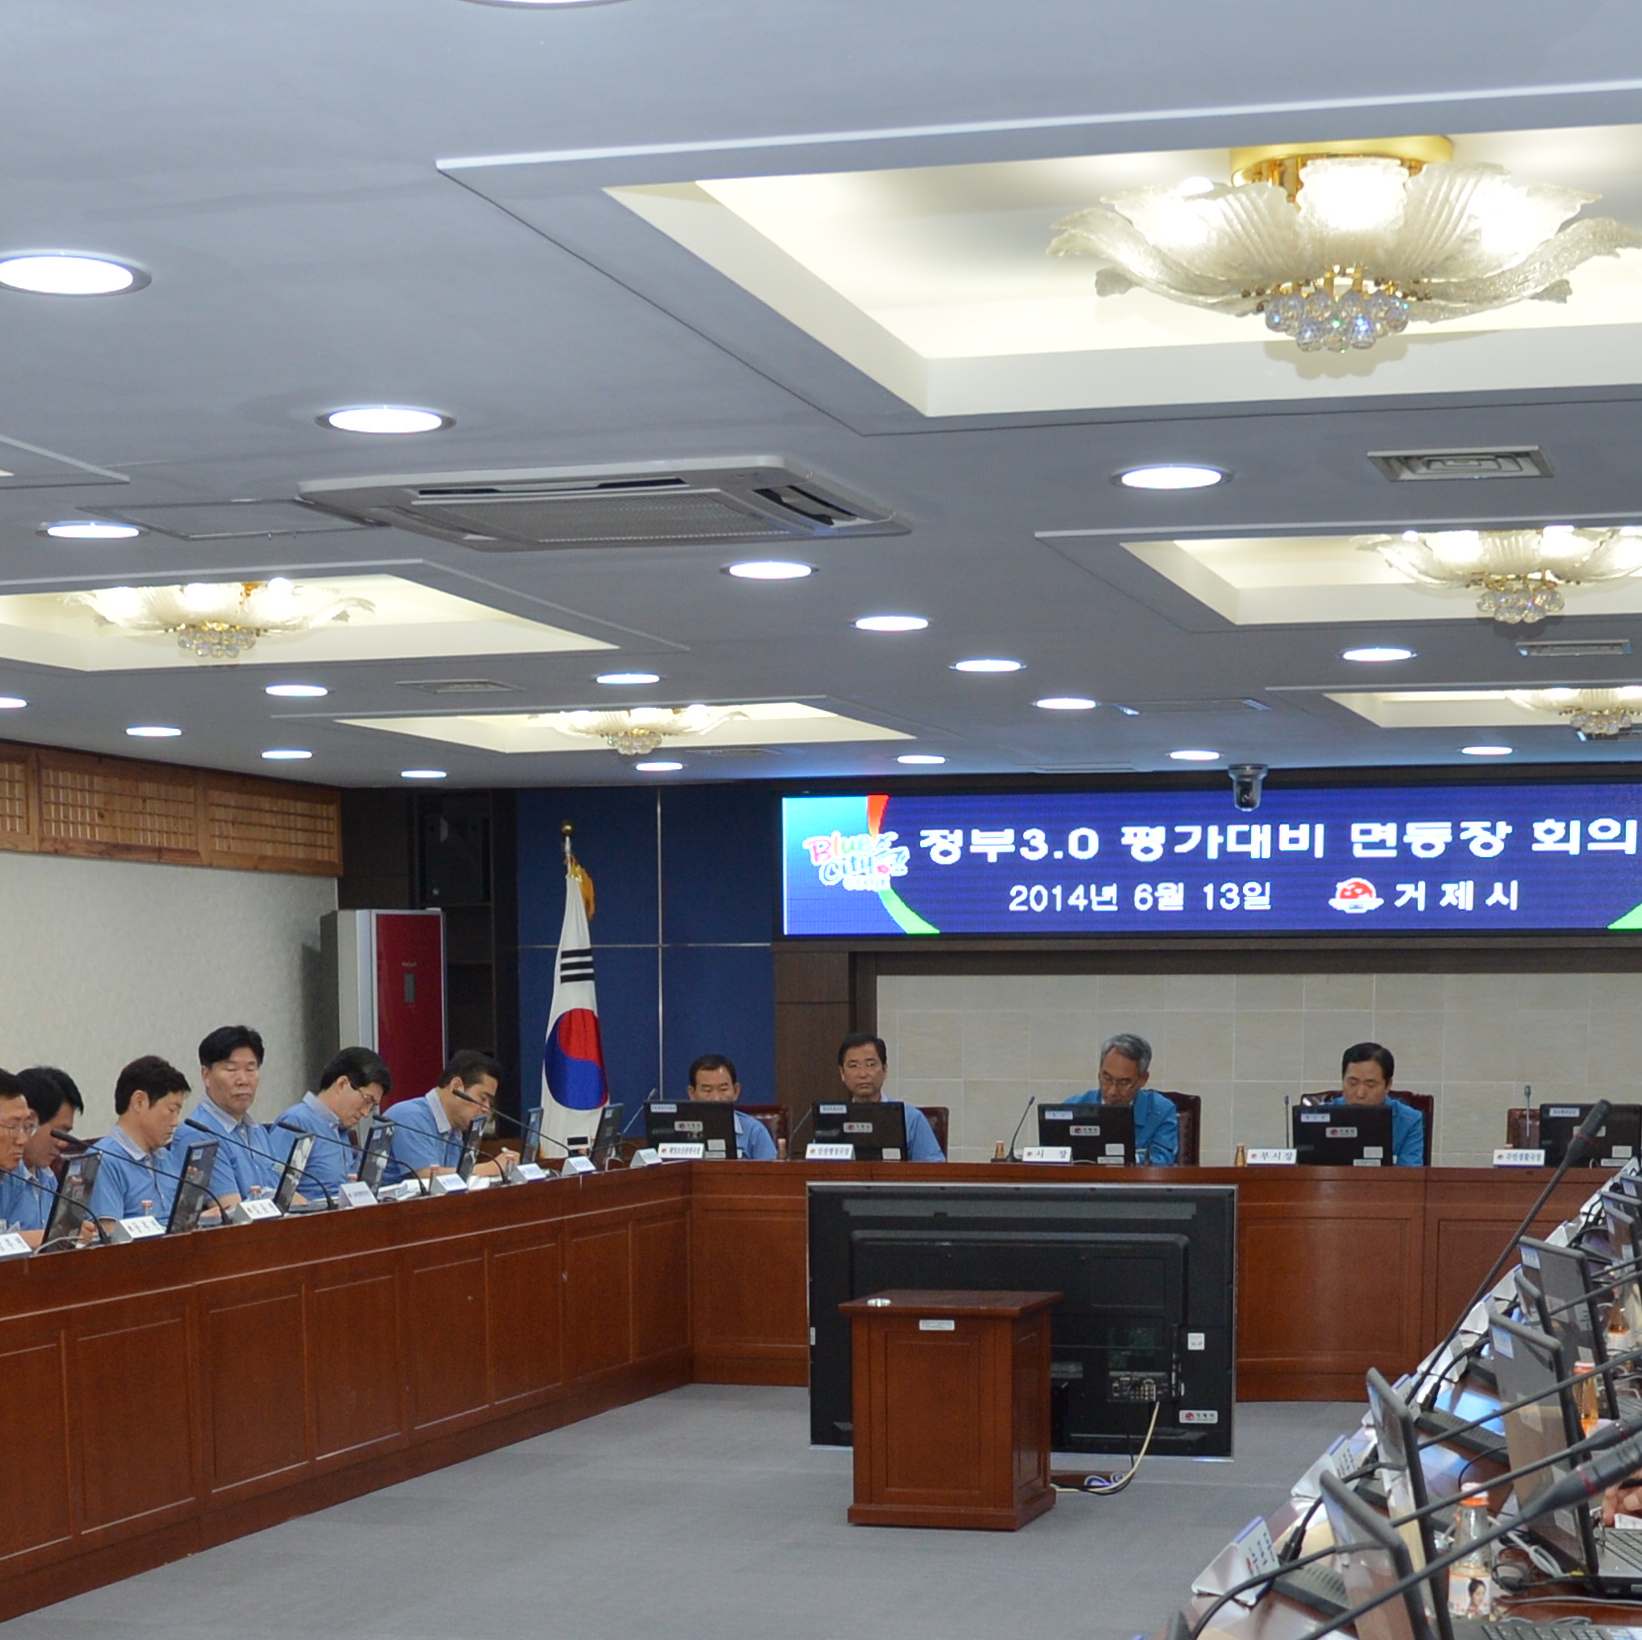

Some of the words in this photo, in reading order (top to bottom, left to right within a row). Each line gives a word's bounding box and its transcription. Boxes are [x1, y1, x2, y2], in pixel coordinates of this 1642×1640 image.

[919, 827, 1099, 865] 정부3.0
[1120, 823, 1325, 862] 평가대비
[1350, 821, 1513, 858] 면동장
[1531, 818, 1638, 856] 회의
[1009, 882, 1118, 912] 2014년
[1134, 881, 1185, 911] 6월
[1203, 880, 1272, 911] 13일
[1394, 879, 1518, 912] 거제시
